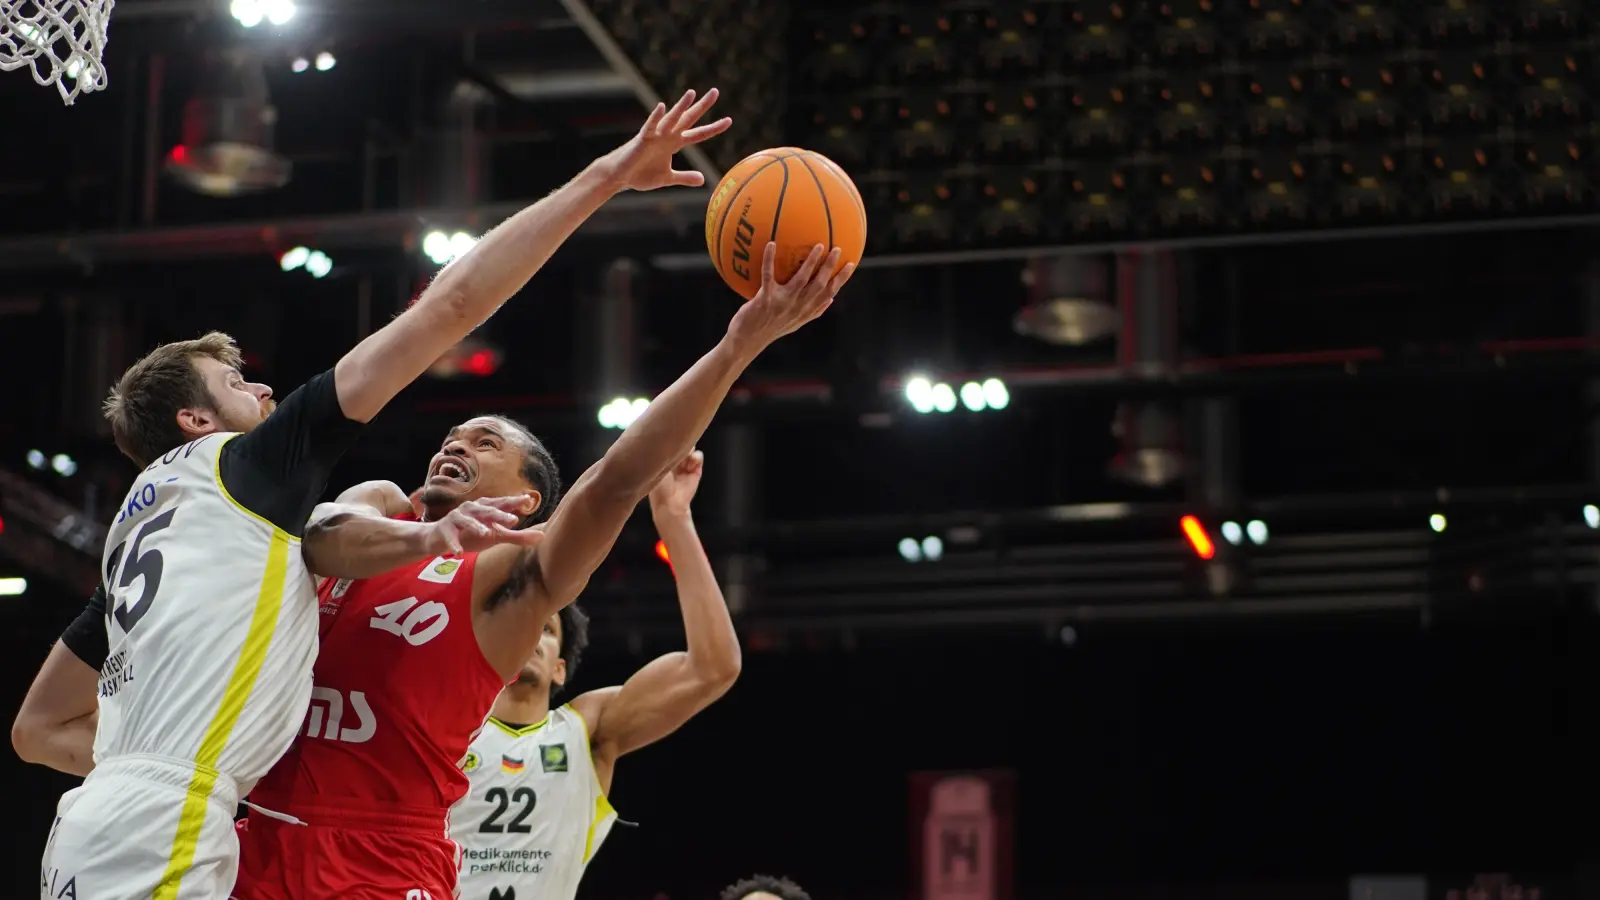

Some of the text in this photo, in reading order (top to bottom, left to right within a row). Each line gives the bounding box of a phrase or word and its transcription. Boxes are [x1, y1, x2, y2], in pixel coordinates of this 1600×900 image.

[731, 220, 756, 281] EVO
[370, 595, 450, 646] 10
[478, 787, 537, 834] 22
